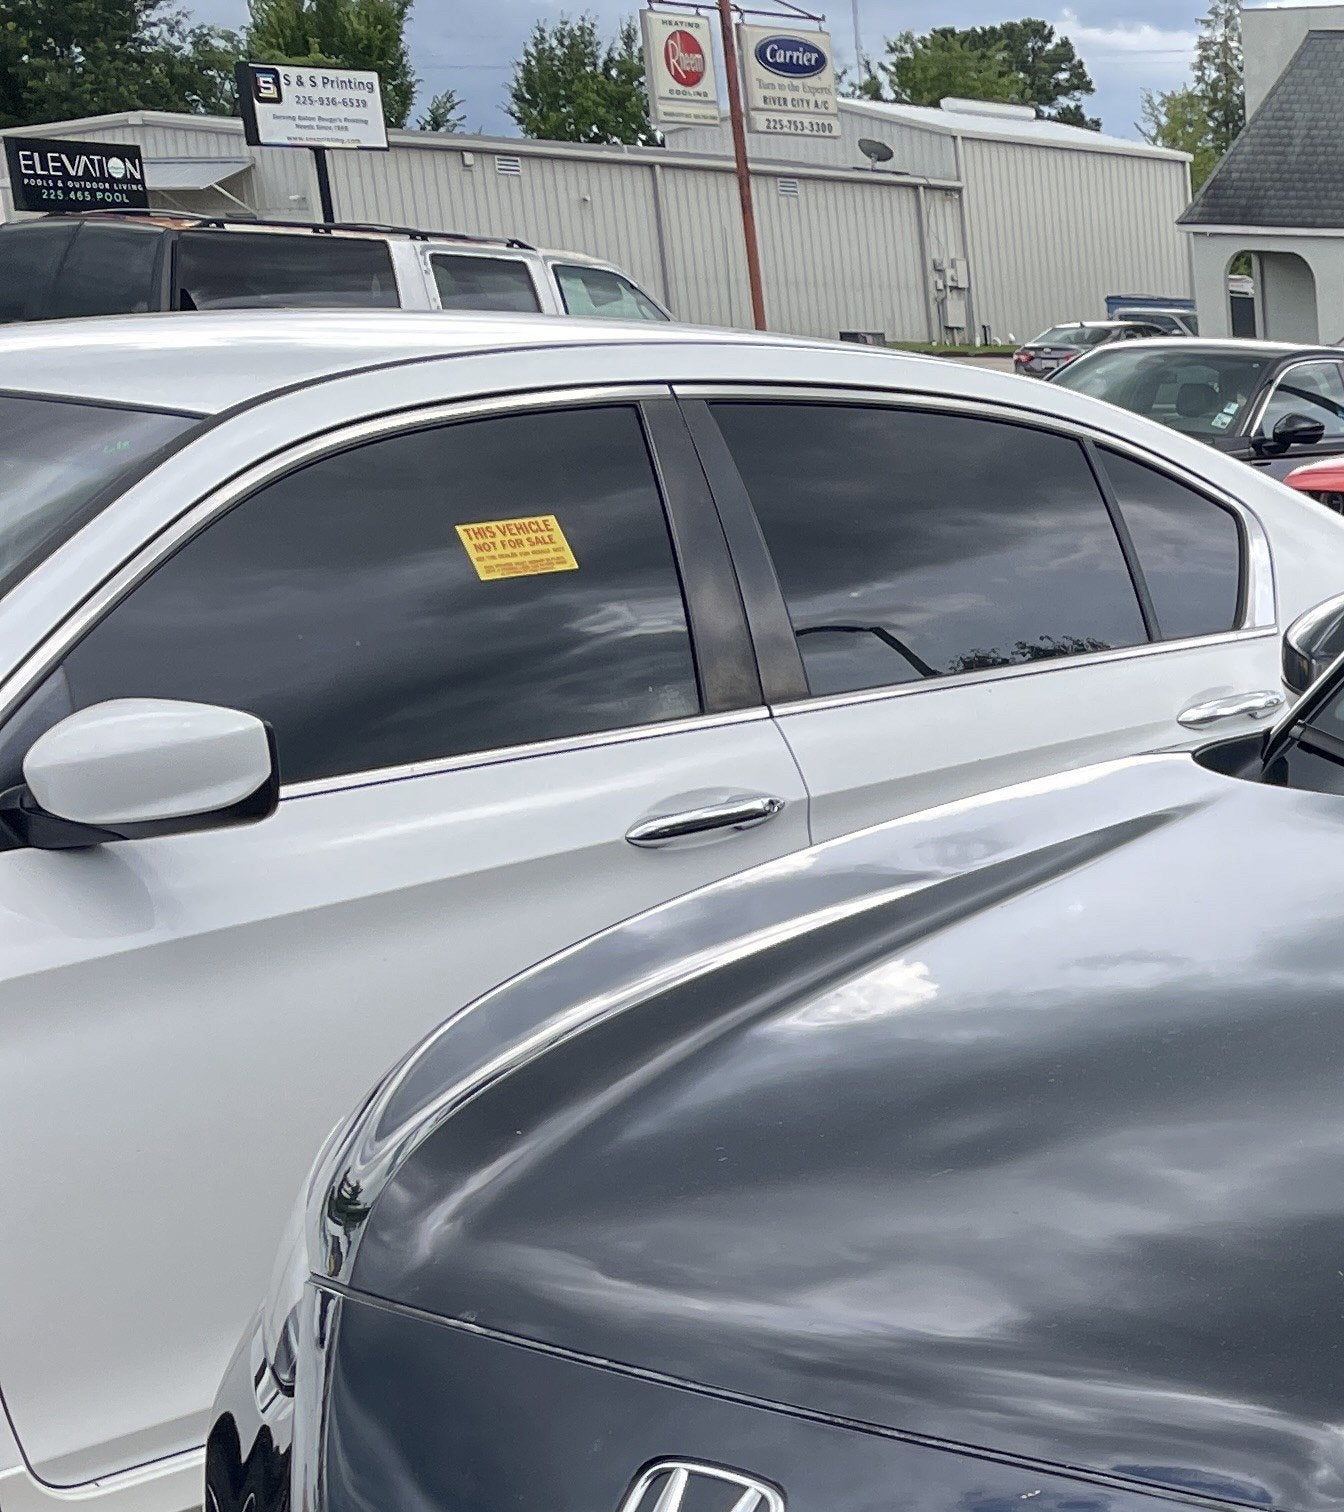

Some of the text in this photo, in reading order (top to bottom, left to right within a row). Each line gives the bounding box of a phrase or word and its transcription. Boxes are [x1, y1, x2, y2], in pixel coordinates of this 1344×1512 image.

[766, 44, 818, 66] Carrier
[283, 74, 374, 94] S & S Printing
[294, 94, 368, 108] 225-936-6539
[762, 94, 829, 110] RIVER CITY A/C
[765, 118, 833, 134] 225-753-3300
[19, 151, 142, 180] ELEVATION
[24, 178, 144, 191] POOLS & OUTDOOR LIVING
[463, 519, 554, 542] THIS VEHICLE
[472, 541, 498, 554] NOT
[500, 539, 524, 550] FOR
[526, 534, 556, 547] SALE
